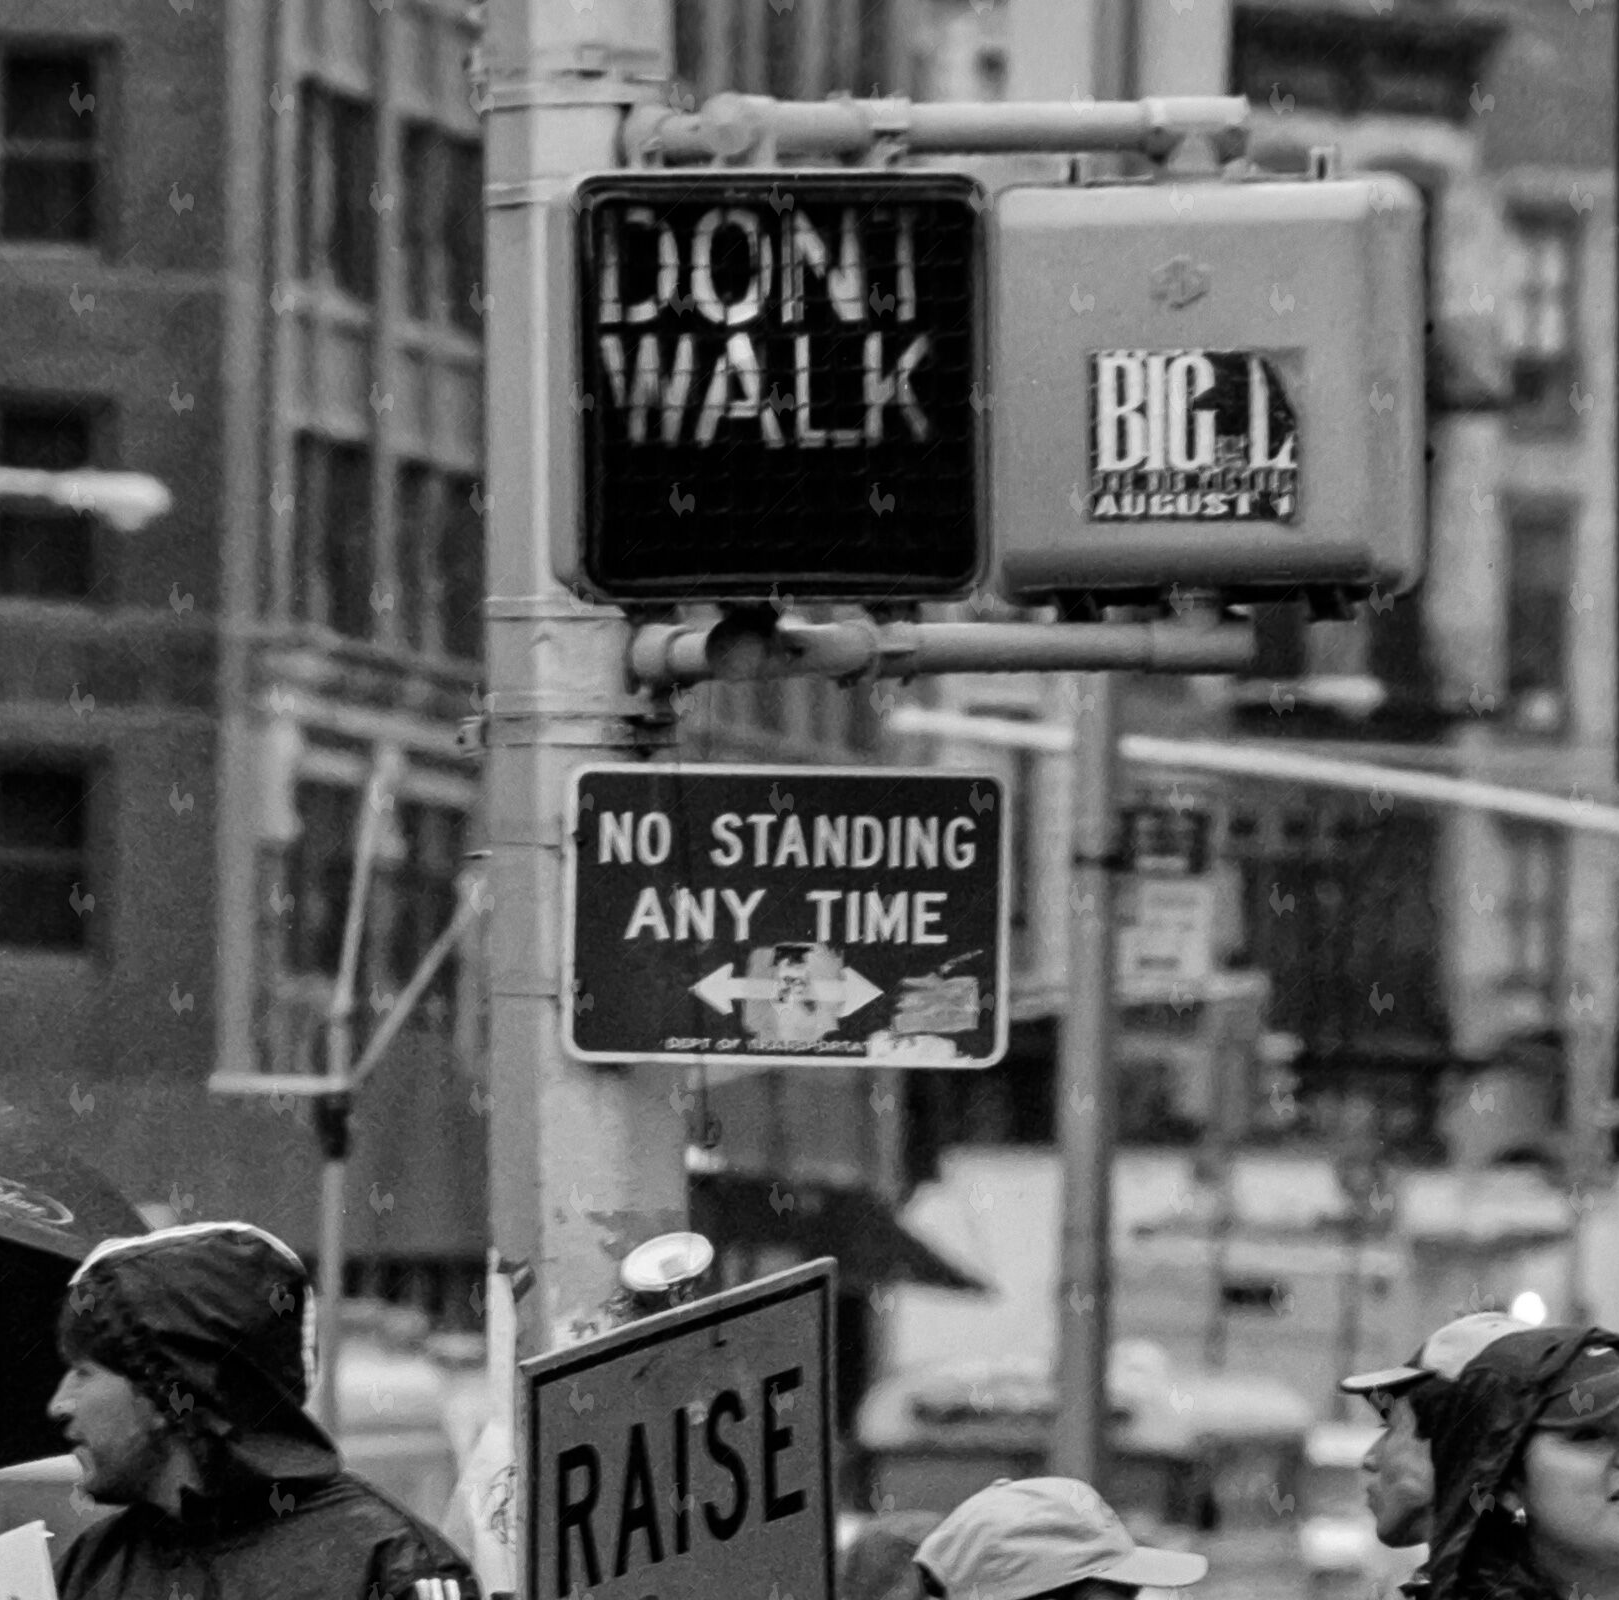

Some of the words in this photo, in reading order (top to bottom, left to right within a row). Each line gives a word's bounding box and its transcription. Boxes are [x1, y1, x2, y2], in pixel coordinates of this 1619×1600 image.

[599, 330, 931, 448] WALK
[1096, 354, 1217, 471] BIG
[1093, 493, 1252, 516] AUGUST
[597, 811, 672, 866] NO
[709, 812, 977, 870] STANDING
[622, 887, 768, 942] ANY
[805, 889, 949, 944] TIME
[556, 1366, 808, 1600] RAISE
